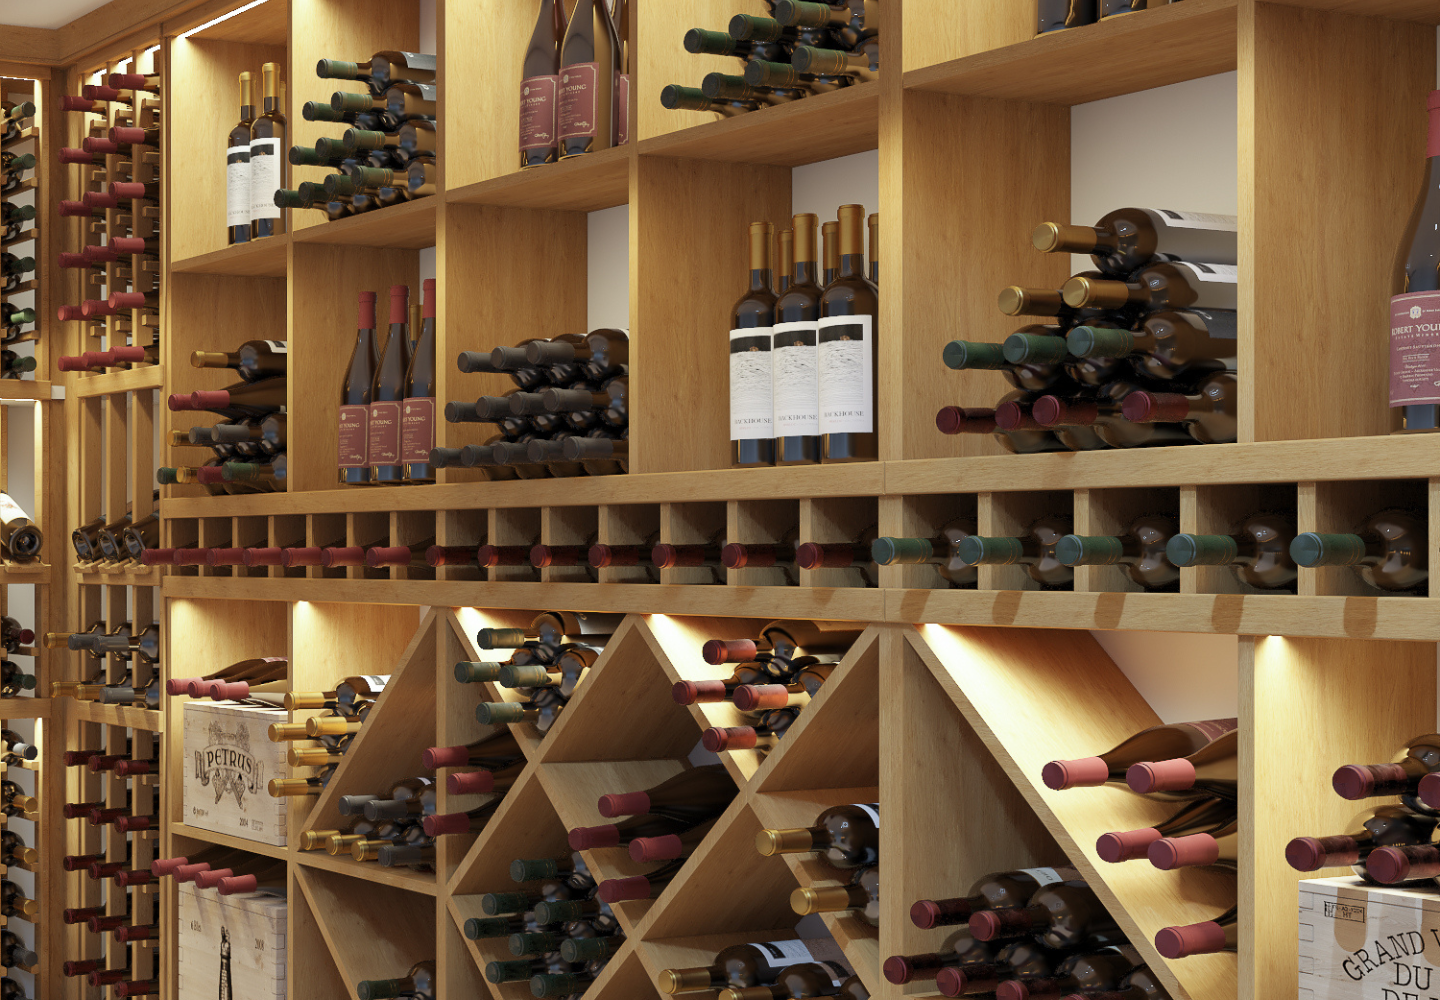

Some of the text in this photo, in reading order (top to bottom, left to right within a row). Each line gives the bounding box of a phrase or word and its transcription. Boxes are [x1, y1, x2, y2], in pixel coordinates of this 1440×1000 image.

[1415, 324, 1440, 332] YOU
[206, 747, 252, 775] PETRUS
[1342, 930, 1425, 981] GRAND
[1392, 961, 1434, 991] DU
